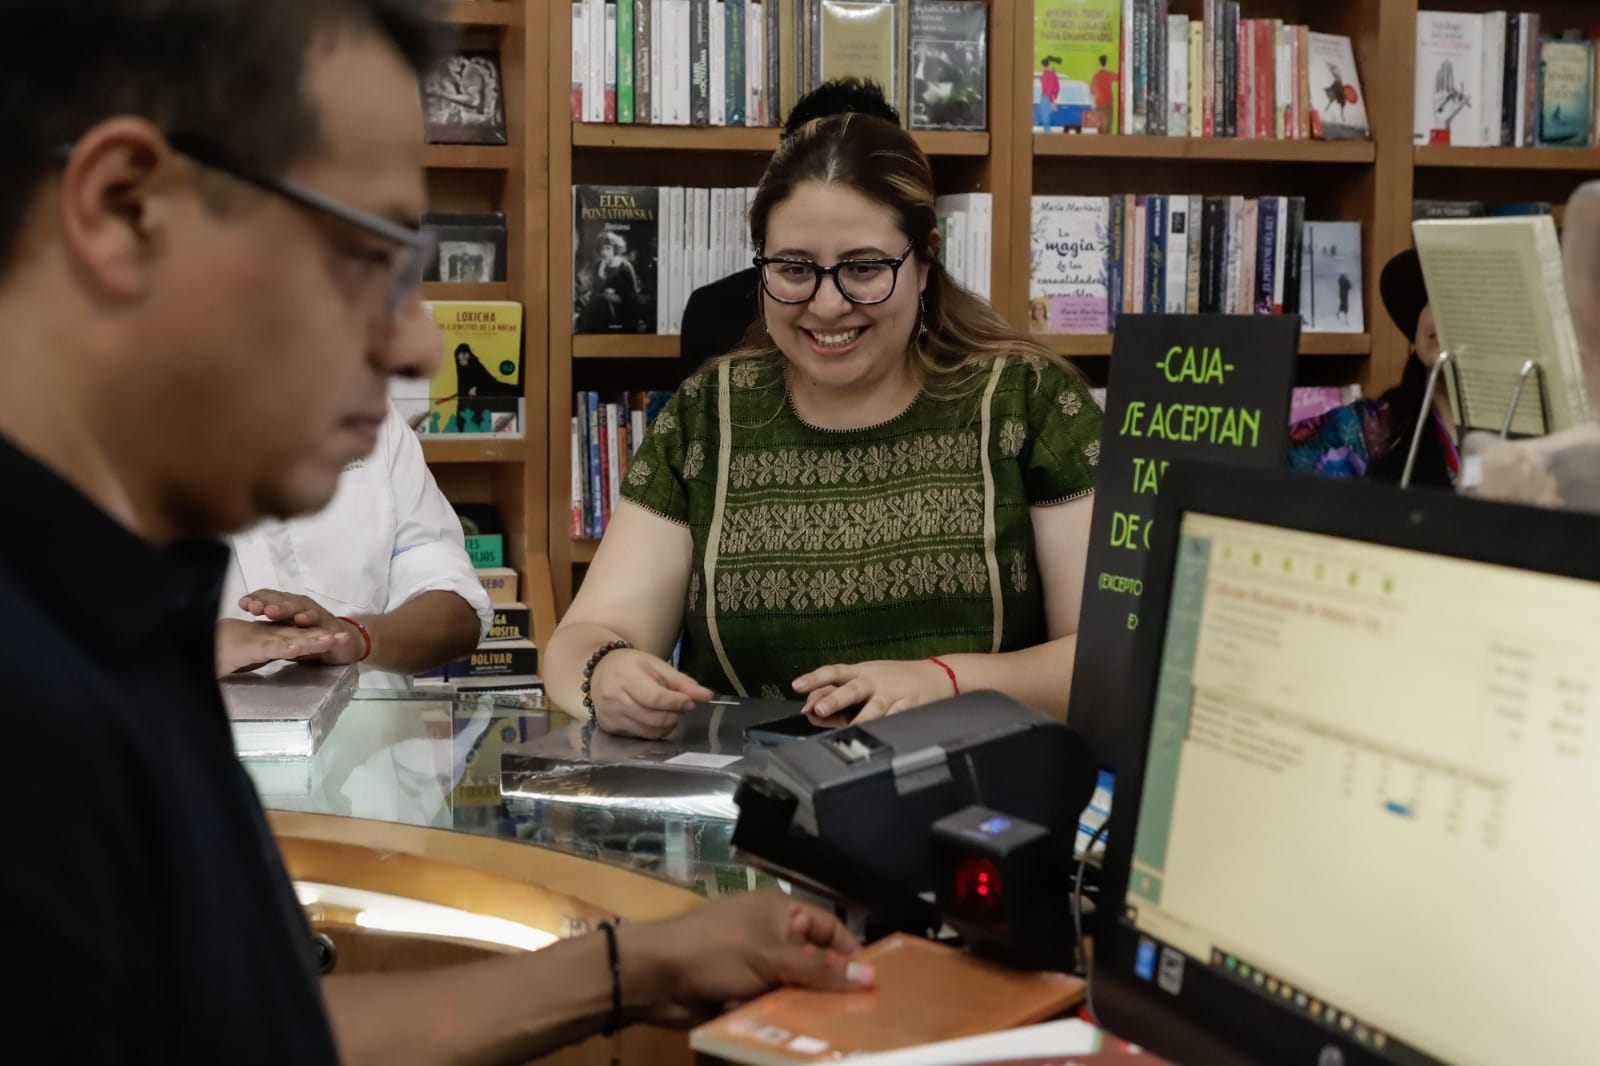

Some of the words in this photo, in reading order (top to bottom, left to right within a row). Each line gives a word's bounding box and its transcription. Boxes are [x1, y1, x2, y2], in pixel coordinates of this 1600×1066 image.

[600, 195, 637, 208] ELENA
[581, 207, 654, 220] PONIATOWSKA
[1045, 238, 1096, 258] magia
[456, 312, 496, 322] LOXICHA
[1156, 346, 1234, 384] -CAJA-
[1120, 401, 1146, 437] SE
[1147, 402, 1261, 447] ACEPTAN
[1110, 511, 1140, 549] DE
